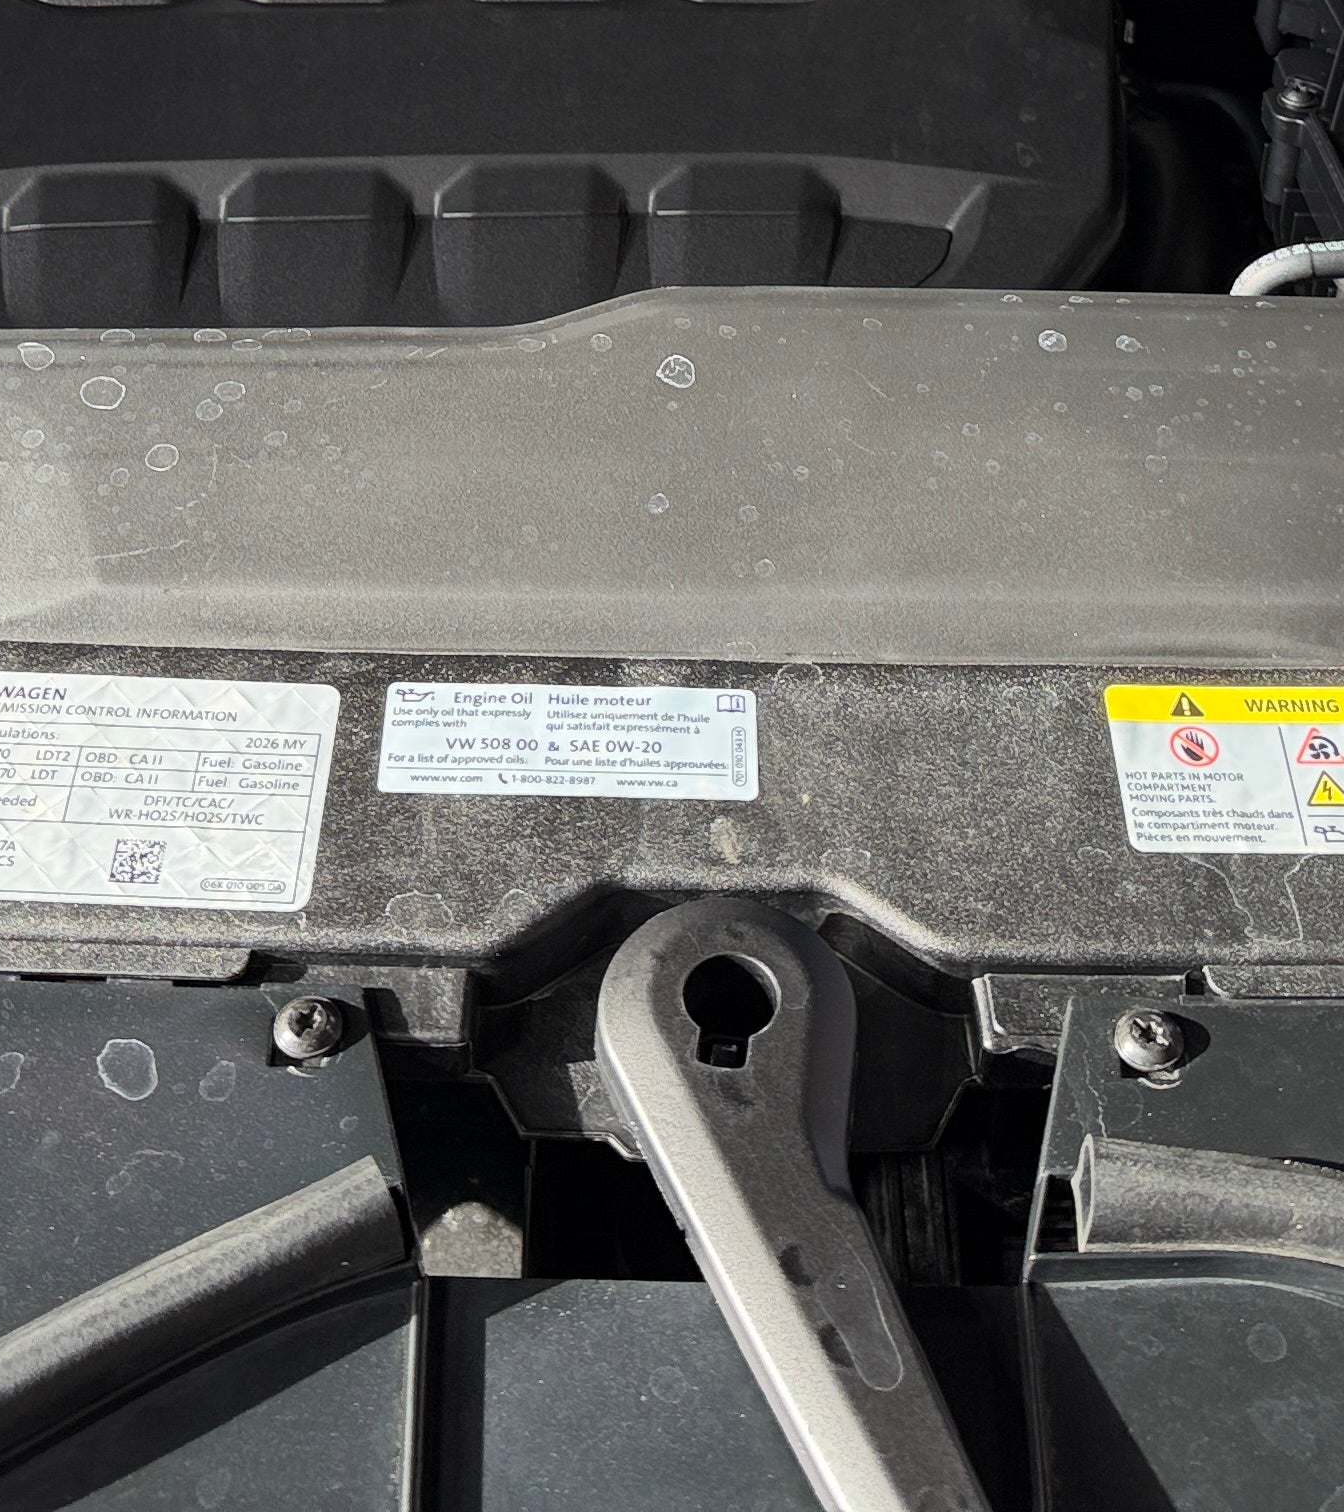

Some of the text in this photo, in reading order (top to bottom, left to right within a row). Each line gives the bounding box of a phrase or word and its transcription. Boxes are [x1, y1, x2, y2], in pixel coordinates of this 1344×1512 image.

[454, 692, 533, 707] Engine Oil
[548, 693, 651, 706] Huile moteur
[1244, 699, 1340, 713] WARNING
[66, 705, 132, 718] CONTROL
[136, 708, 237, 722] INFORMATION
[393, 707, 532, 720] Use only oil that expressly
[547, 709, 711, 723] Utilisez uniquement de l'huile
[391, 718, 467, 729] complies with
[546, 721, 700, 735] qui satisfait expressément à
[245, 737, 307, 750] 2026 MY
[446, 737, 663, 754] VW 508 00 & SAE 0W-20
[36, 750, 70, 761] LDT2
[388, 753, 405, 762] For
[418, 753, 433, 763] list
[436, 754, 449, 763] of
[451, 754, 503, 765] approved
[544, 756, 569, 766] Pour
[572, 758, 593, 767] une
[595, 757, 617, 767] liste
[619, 757, 661, 768] d'huiles
[242, 758, 303, 772] Gasoline
[30, 769, 58, 780] LDT
[410, 774, 678, 788] www.vw.com 1-800-822-8987 www.vw.ca
[1125, 771, 1244, 782] HOT PARTS IN MOTOR
[239, 778, 300, 791] Gasoline
[1129, 794, 1216, 804] MOVING PARTS.
[108, 808, 264, 825] WR-HO2S/HO2S/TWC
[1131, 807, 1294, 819] Composants très chauds dans
[1133, 820, 1144, 829] le
[1147, 820, 1230, 831] compartiment
[1136, 831, 1266, 843] Pièces en mouvement.
